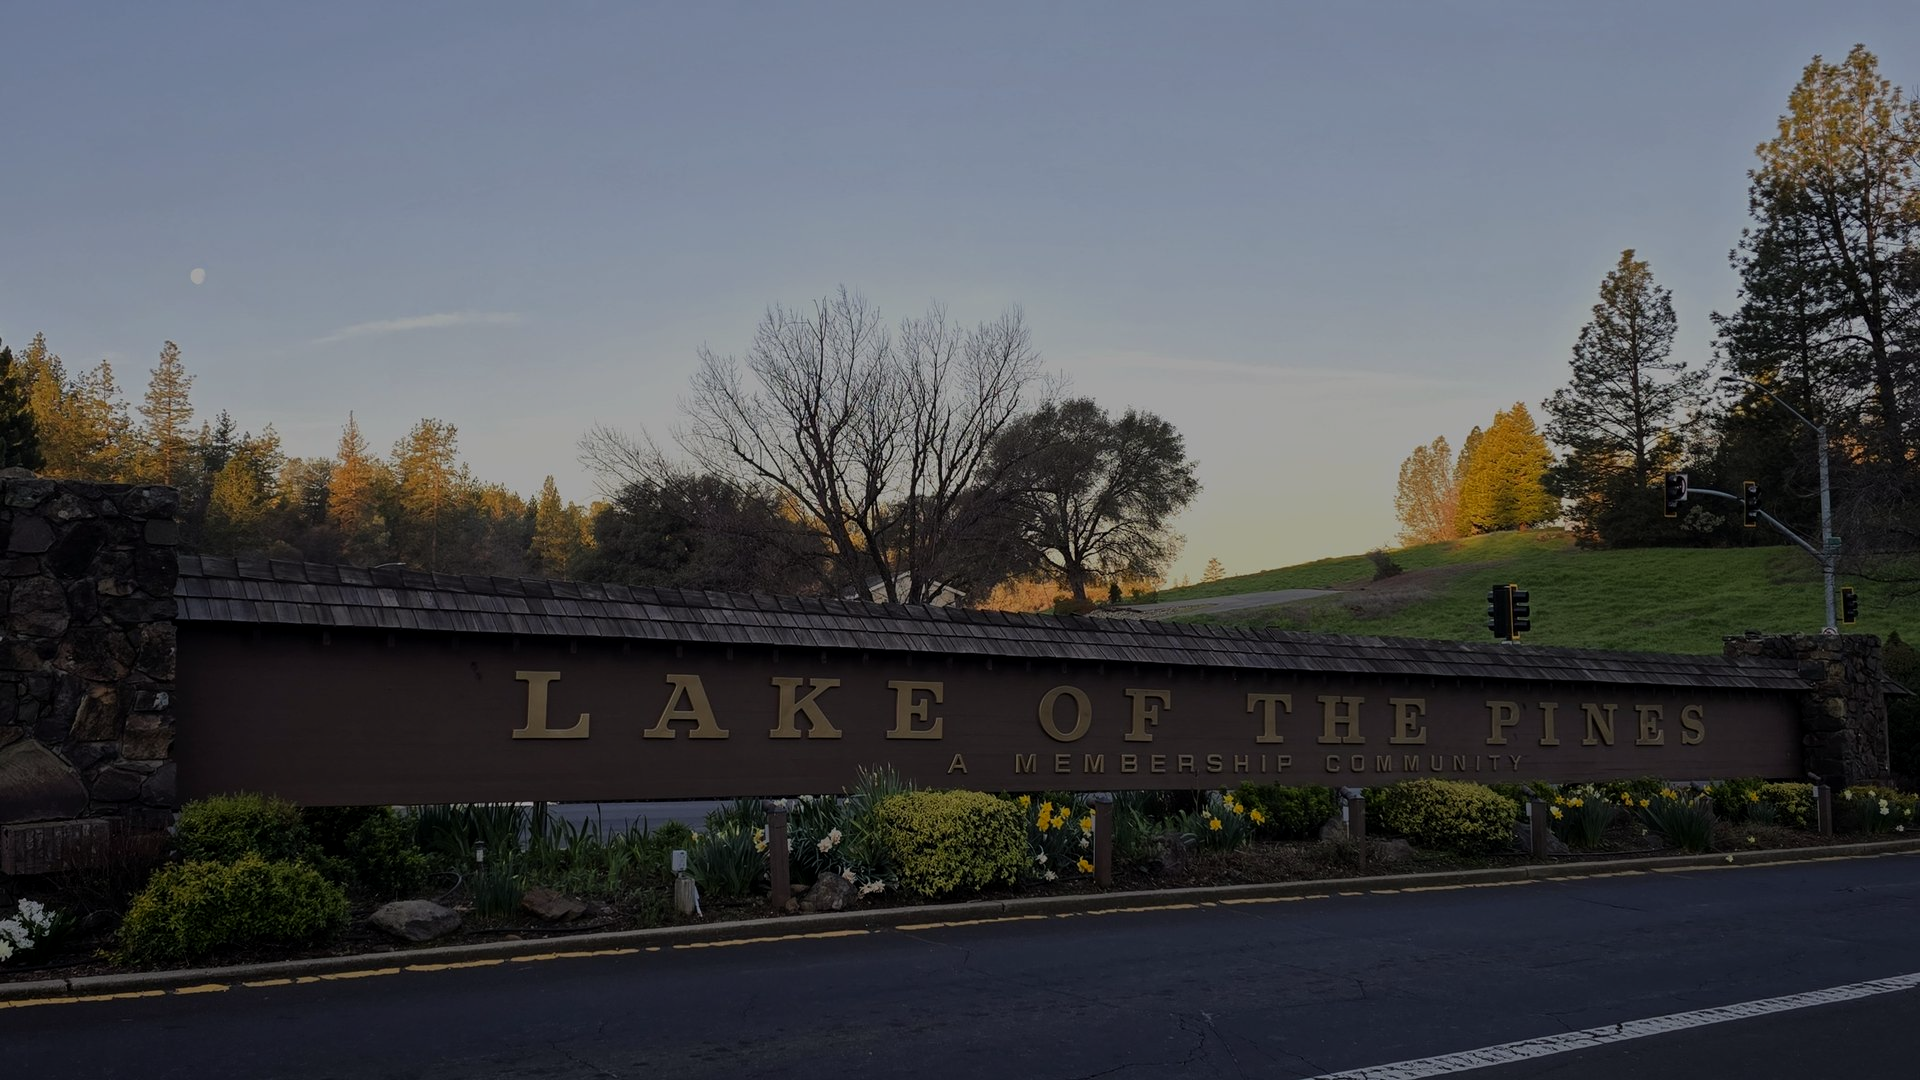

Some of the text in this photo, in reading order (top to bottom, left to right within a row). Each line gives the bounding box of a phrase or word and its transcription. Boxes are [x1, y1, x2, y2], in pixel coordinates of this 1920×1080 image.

[512, 670, 1706, 746] LAKE OF THE PINES
[947, 753, 1522, 774] A MEMBERSHIP COMMUNITY
